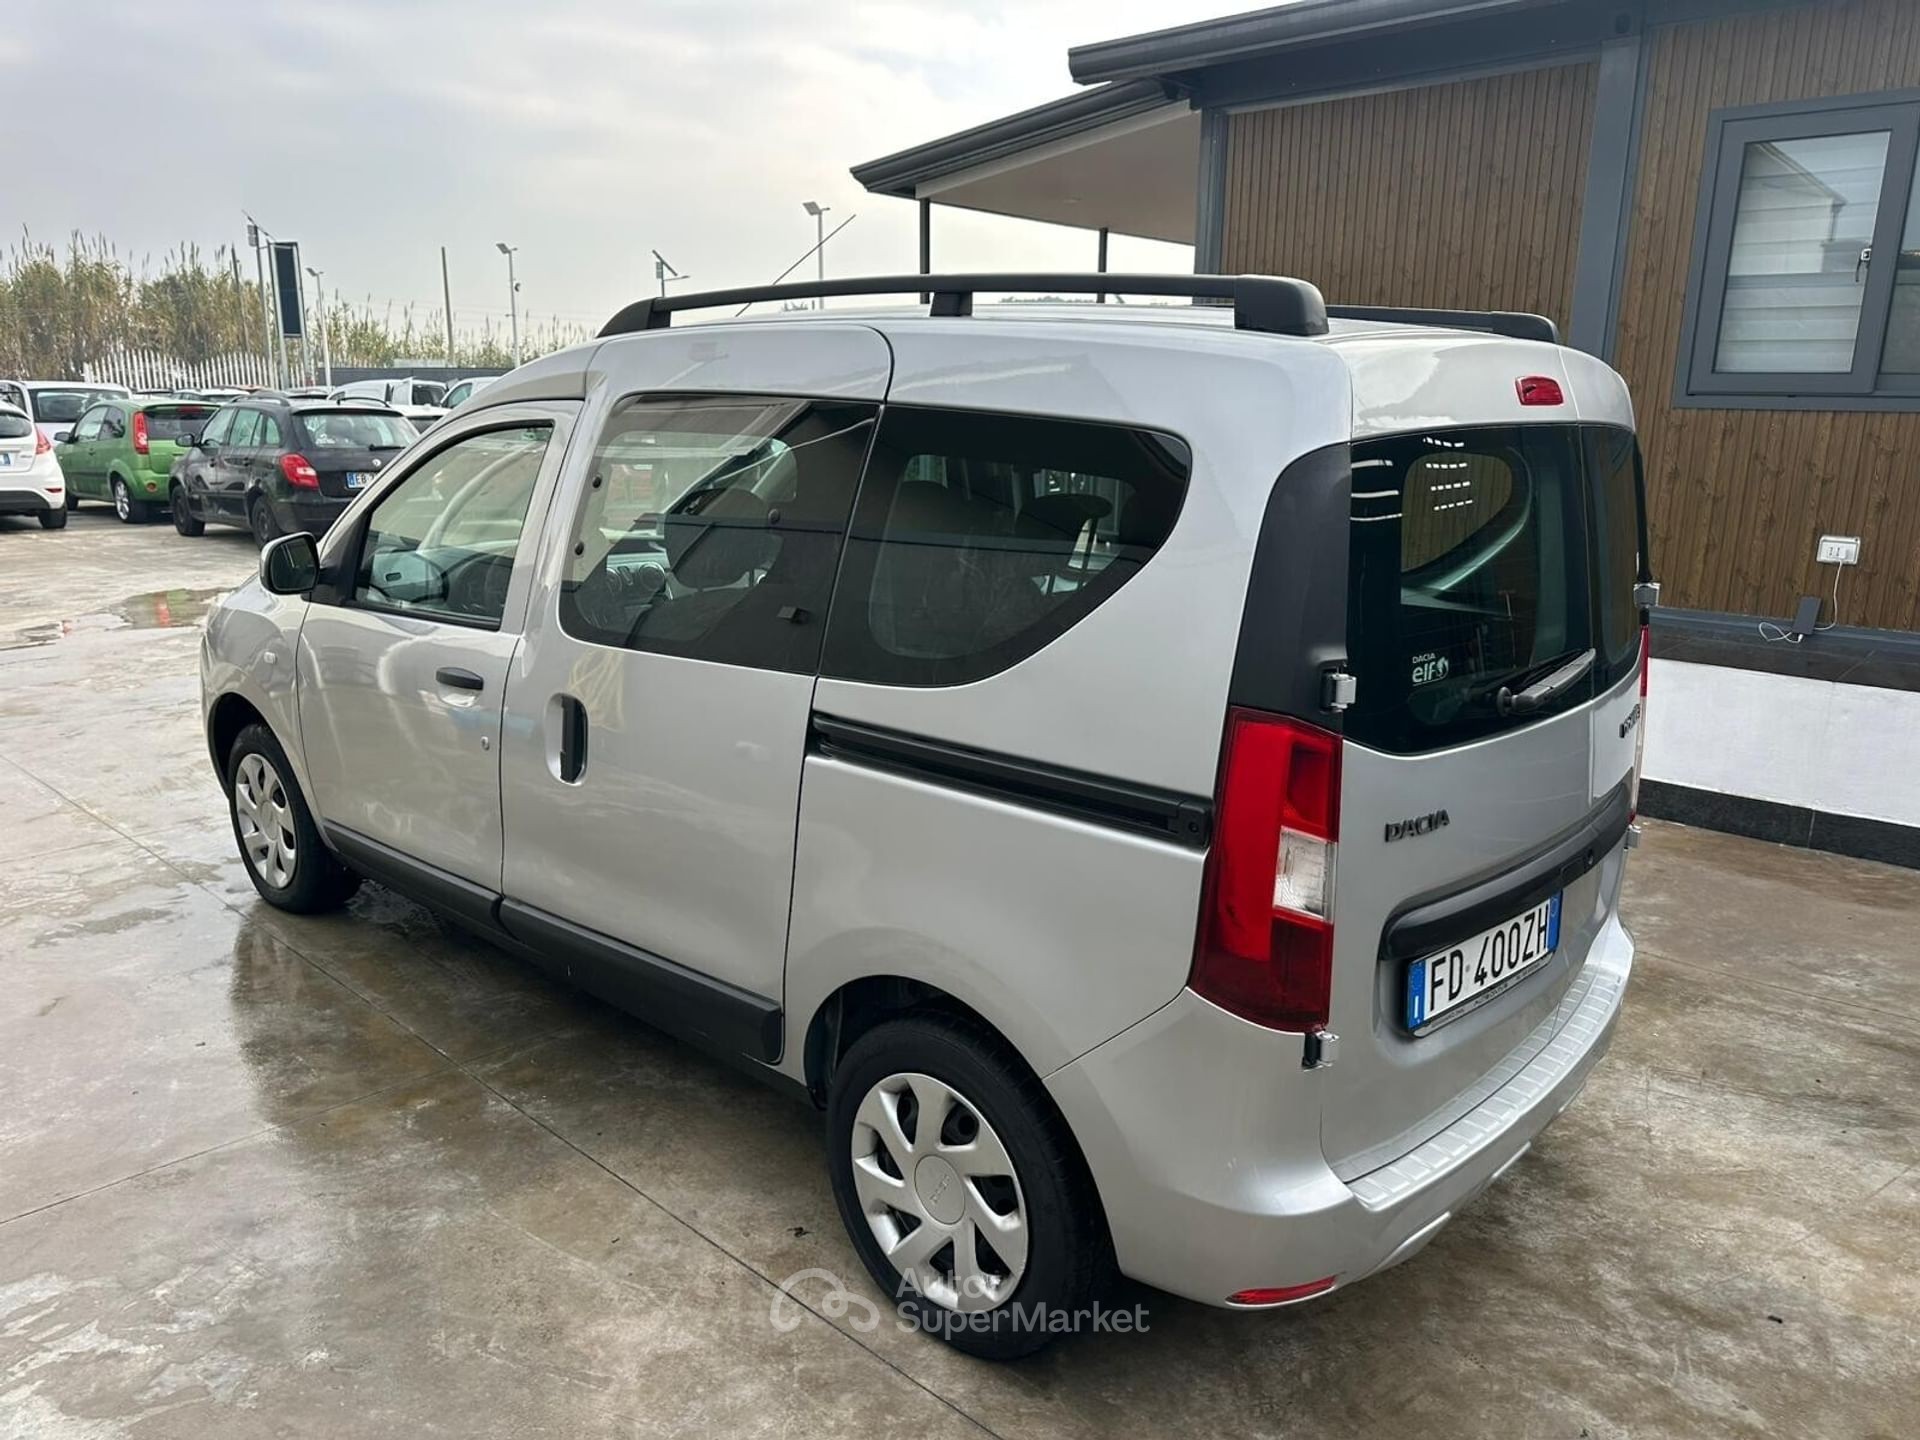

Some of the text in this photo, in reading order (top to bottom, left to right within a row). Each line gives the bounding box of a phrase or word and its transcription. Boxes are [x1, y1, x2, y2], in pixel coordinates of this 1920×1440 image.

[1412, 652, 1436, 664] DACIA
[1412, 661, 1436, 683] elf
[1384, 809, 1450, 843] DACIA
[1430, 904, 1549, 1011] FD 400ZH
